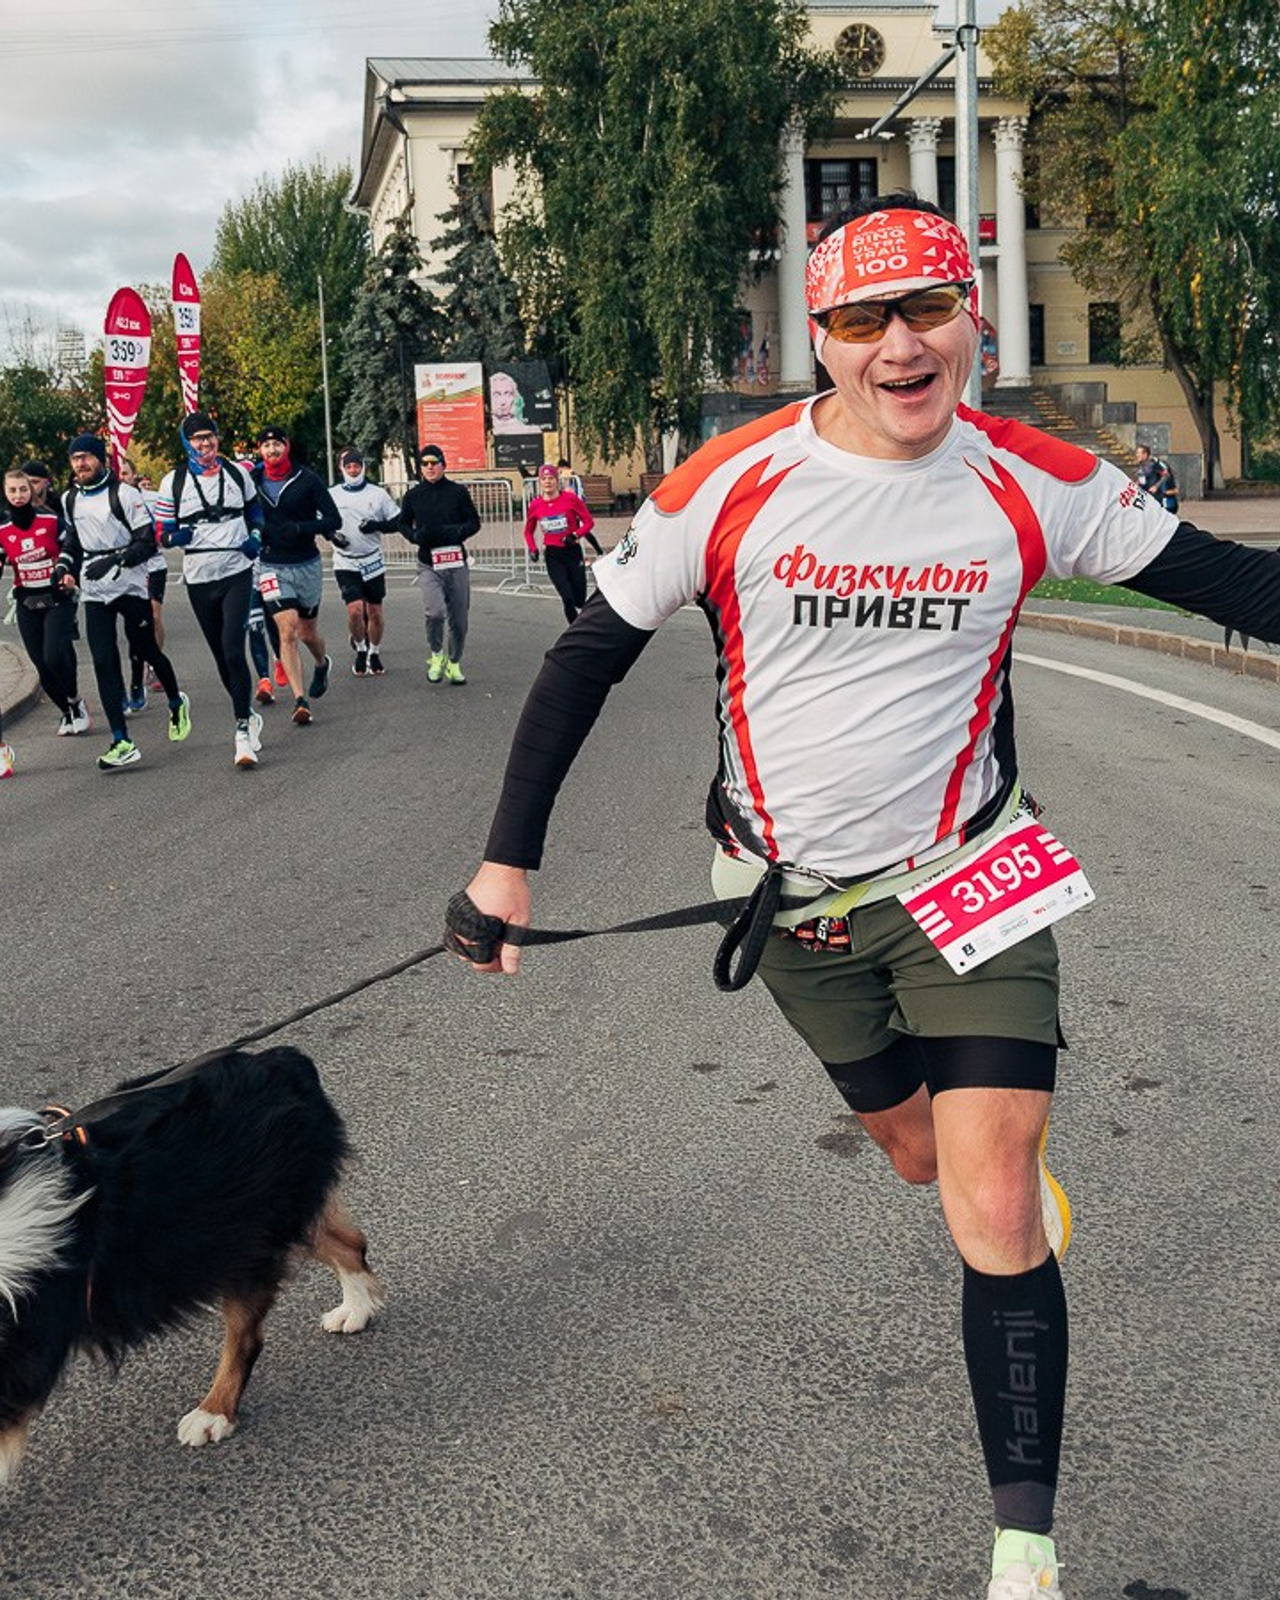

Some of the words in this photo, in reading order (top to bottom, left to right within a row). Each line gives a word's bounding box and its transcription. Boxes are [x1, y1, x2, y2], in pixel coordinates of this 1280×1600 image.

[852, 230, 906, 248] RING
[853, 238, 906, 256] ULTRA
[853, 245, 908, 262] TRAIL
[855, 254, 909, 277] 100
[773, 544, 989, 598] Физкульт
[793, 595, 970, 631] ПРИВЕТ
[951, 842, 1042, 914] 3195
